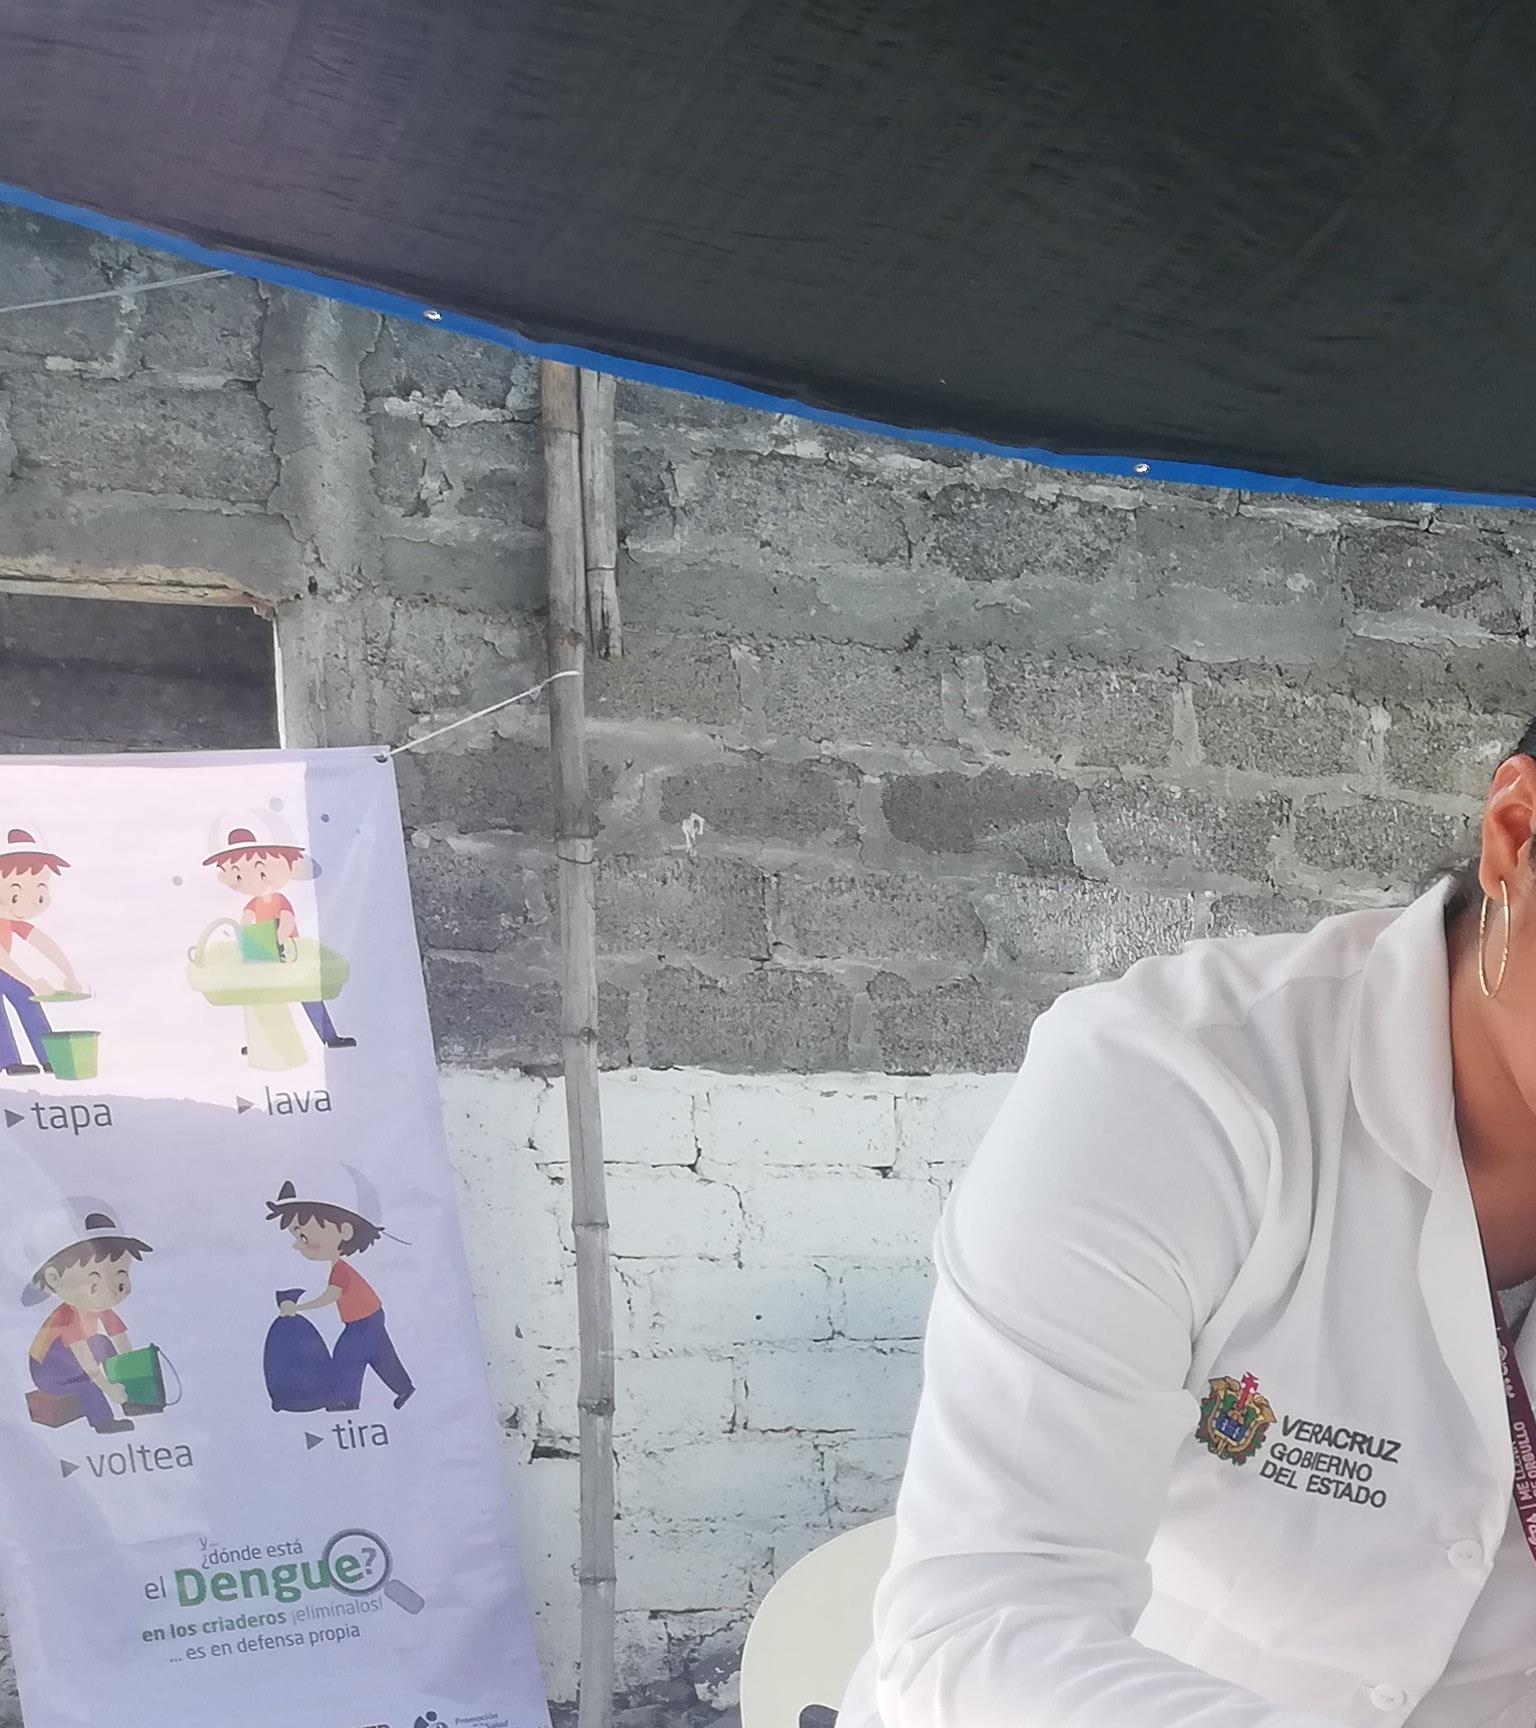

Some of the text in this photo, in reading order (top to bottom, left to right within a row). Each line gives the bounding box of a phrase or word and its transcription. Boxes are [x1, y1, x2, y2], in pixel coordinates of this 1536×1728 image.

[265, 1086, 332, 1114] lava
[31, 1102, 113, 1135] tapa
[333, 1419, 389, 1450] tira
[1281, 1415, 1402, 1464] VERACRUZ
[87, 1443, 194, 1477] voltea
[1269, 1442, 1373, 1482] GOBIERNO
[1259, 1460, 1387, 1508] DEL ESTADO
[201, 1539, 303, 1570] ¿dónde está
[144, 1547, 377, 1608] el Dengue?
[142, 1626, 166, 1643] en
[171, 1622, 197, 1640] los
[202, 1609, 287, 1634] criaderos
[186, 1646, 207, 1661] es
[211, 1642, 233, 1657] en
[237, 1632, 305, 1654] defensa
[309, 1624, 361, 1647] propia
